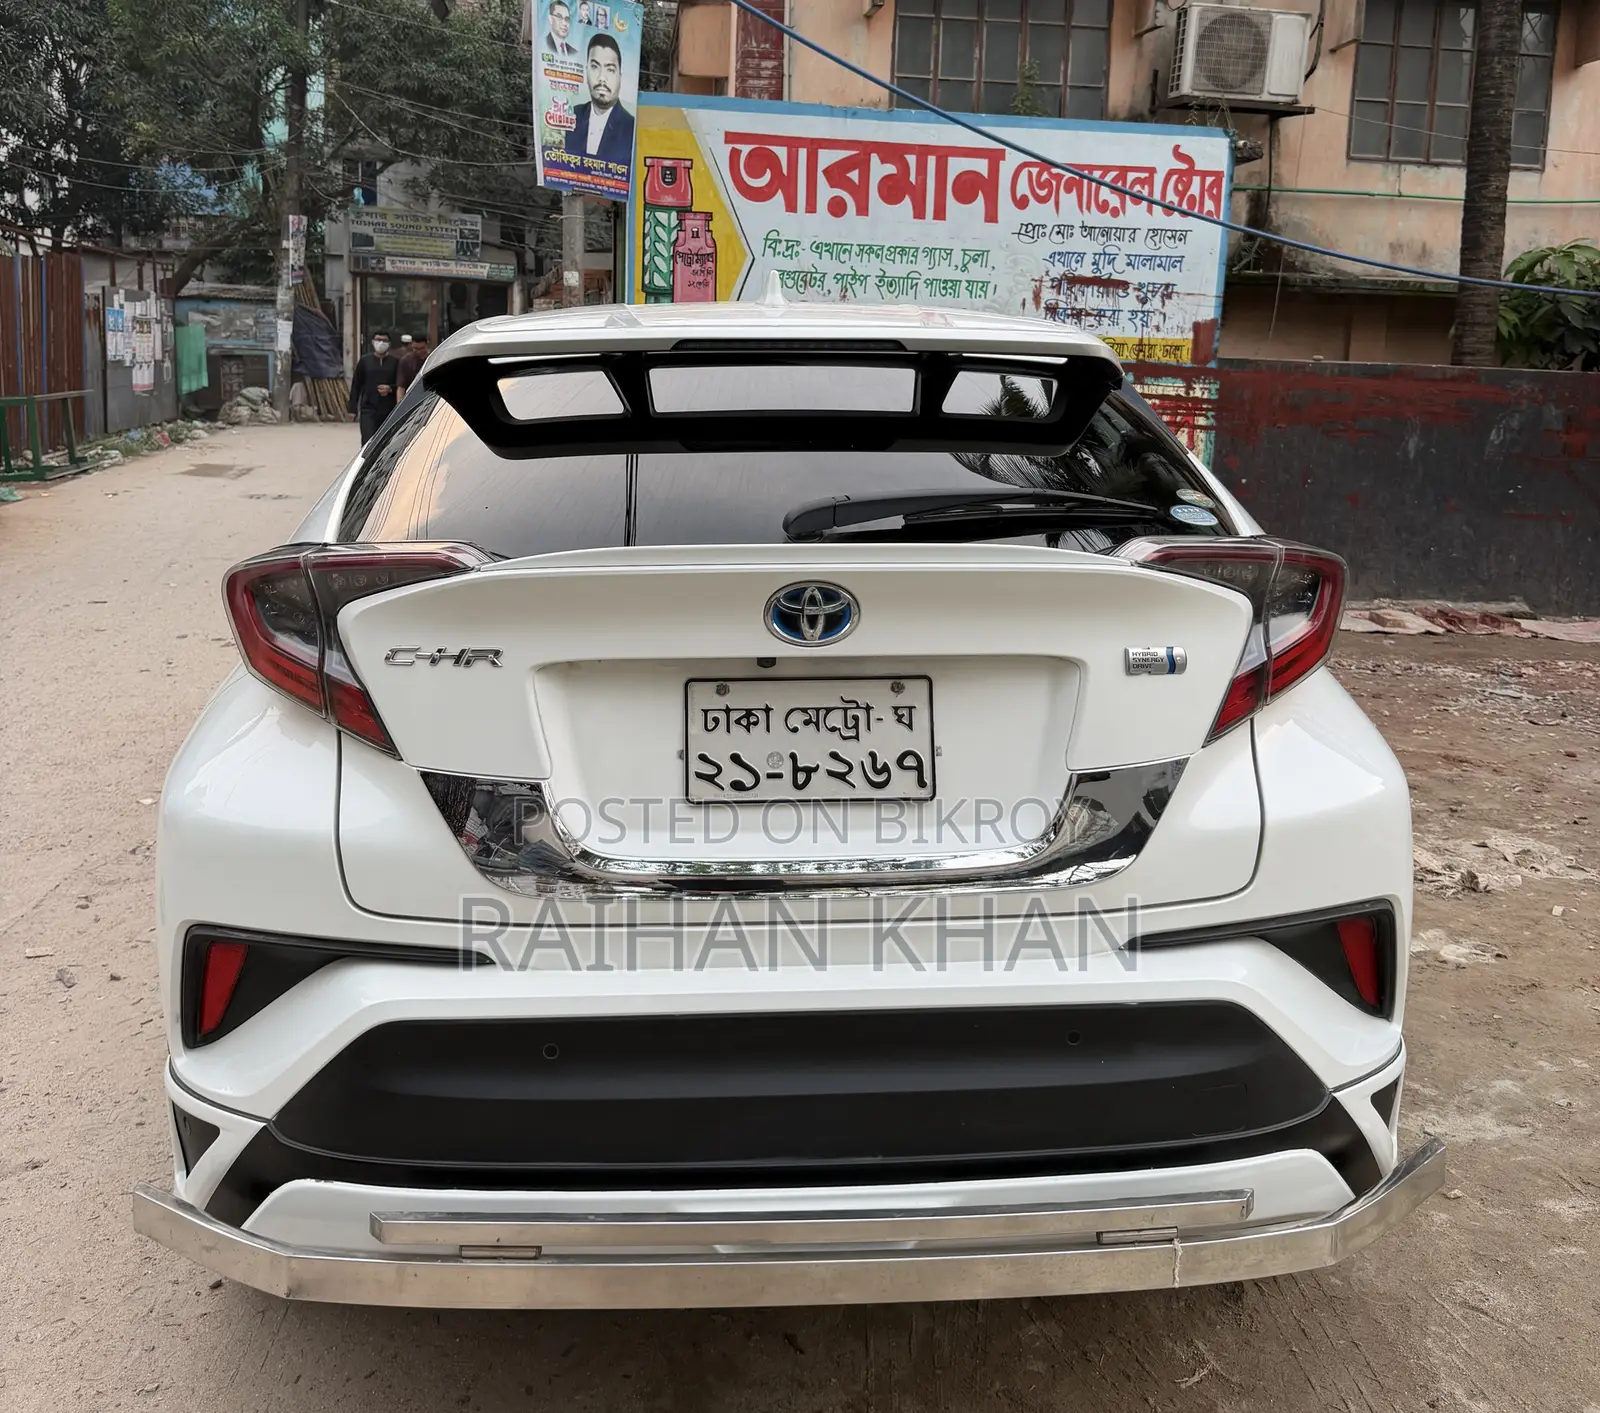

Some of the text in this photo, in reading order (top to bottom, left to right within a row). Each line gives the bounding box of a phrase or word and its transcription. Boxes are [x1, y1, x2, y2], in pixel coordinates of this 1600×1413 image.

[544, 147, 581, 169] তৌফিকুর
[582, 157, 606, 171] রহমান
[607, 161, 629, 176] শাওন
[724, 131, 1006, 224] আরমান
[1010, 161, 1157, 219] জেনারেল
[351, 219, 388, 229] TUSHAR
[390, 222, 422, 231] SOUND
[425, 225, 458, 234] SYSTEM
[1049, 223, 1075, 244] মোঃ
[1078, 220, 1141, 246] আনোয়ার
[1144, 228, 1193, 250] হোসেন
[810, 240, 852, 264] এখানে
[855, 243, 884, 264] সকল
[885, 245, 919, 265] প্রকার
[1043, 245, 1185, 274] এখানে মুদি মালামাল
[833, 266, 871, 299] পাইপ
[874, 268, 922, 300] ইত্যাদি
[923, 277, 962, 299] পাওয়া
[384, 645, 503, 668] C-HR
[701, 703, 774, 734] ঢাকা
[694, 750, 928, 791] ২১-৮২৬৭
